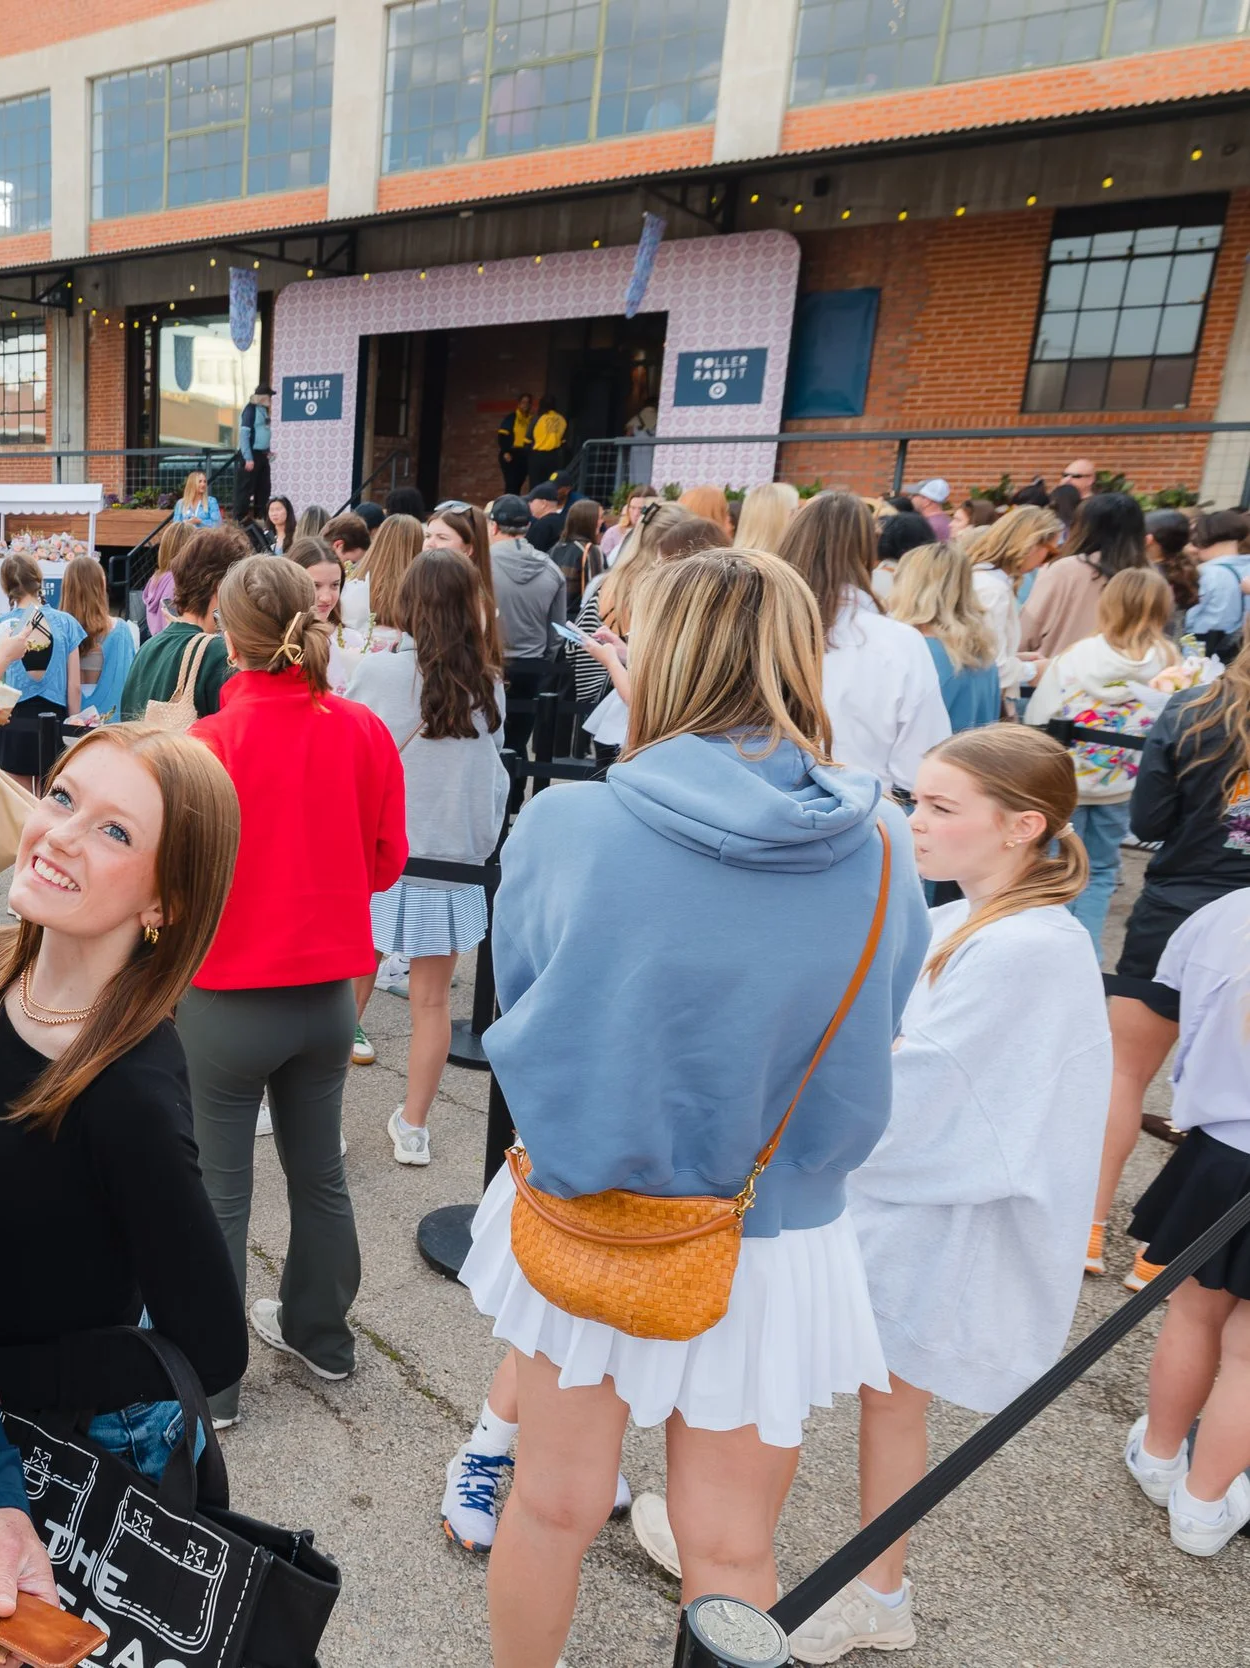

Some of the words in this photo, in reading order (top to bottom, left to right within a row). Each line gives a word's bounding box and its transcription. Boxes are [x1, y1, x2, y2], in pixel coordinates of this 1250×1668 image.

[694, 355, 748, 369] ROLLER
[693, 367, 747, 380] RABBIT
[293, 380, 331, 391] ROLLER
[293, 390, 330, 400] RABBIT
[44, 1518, 128, 1608] THE
